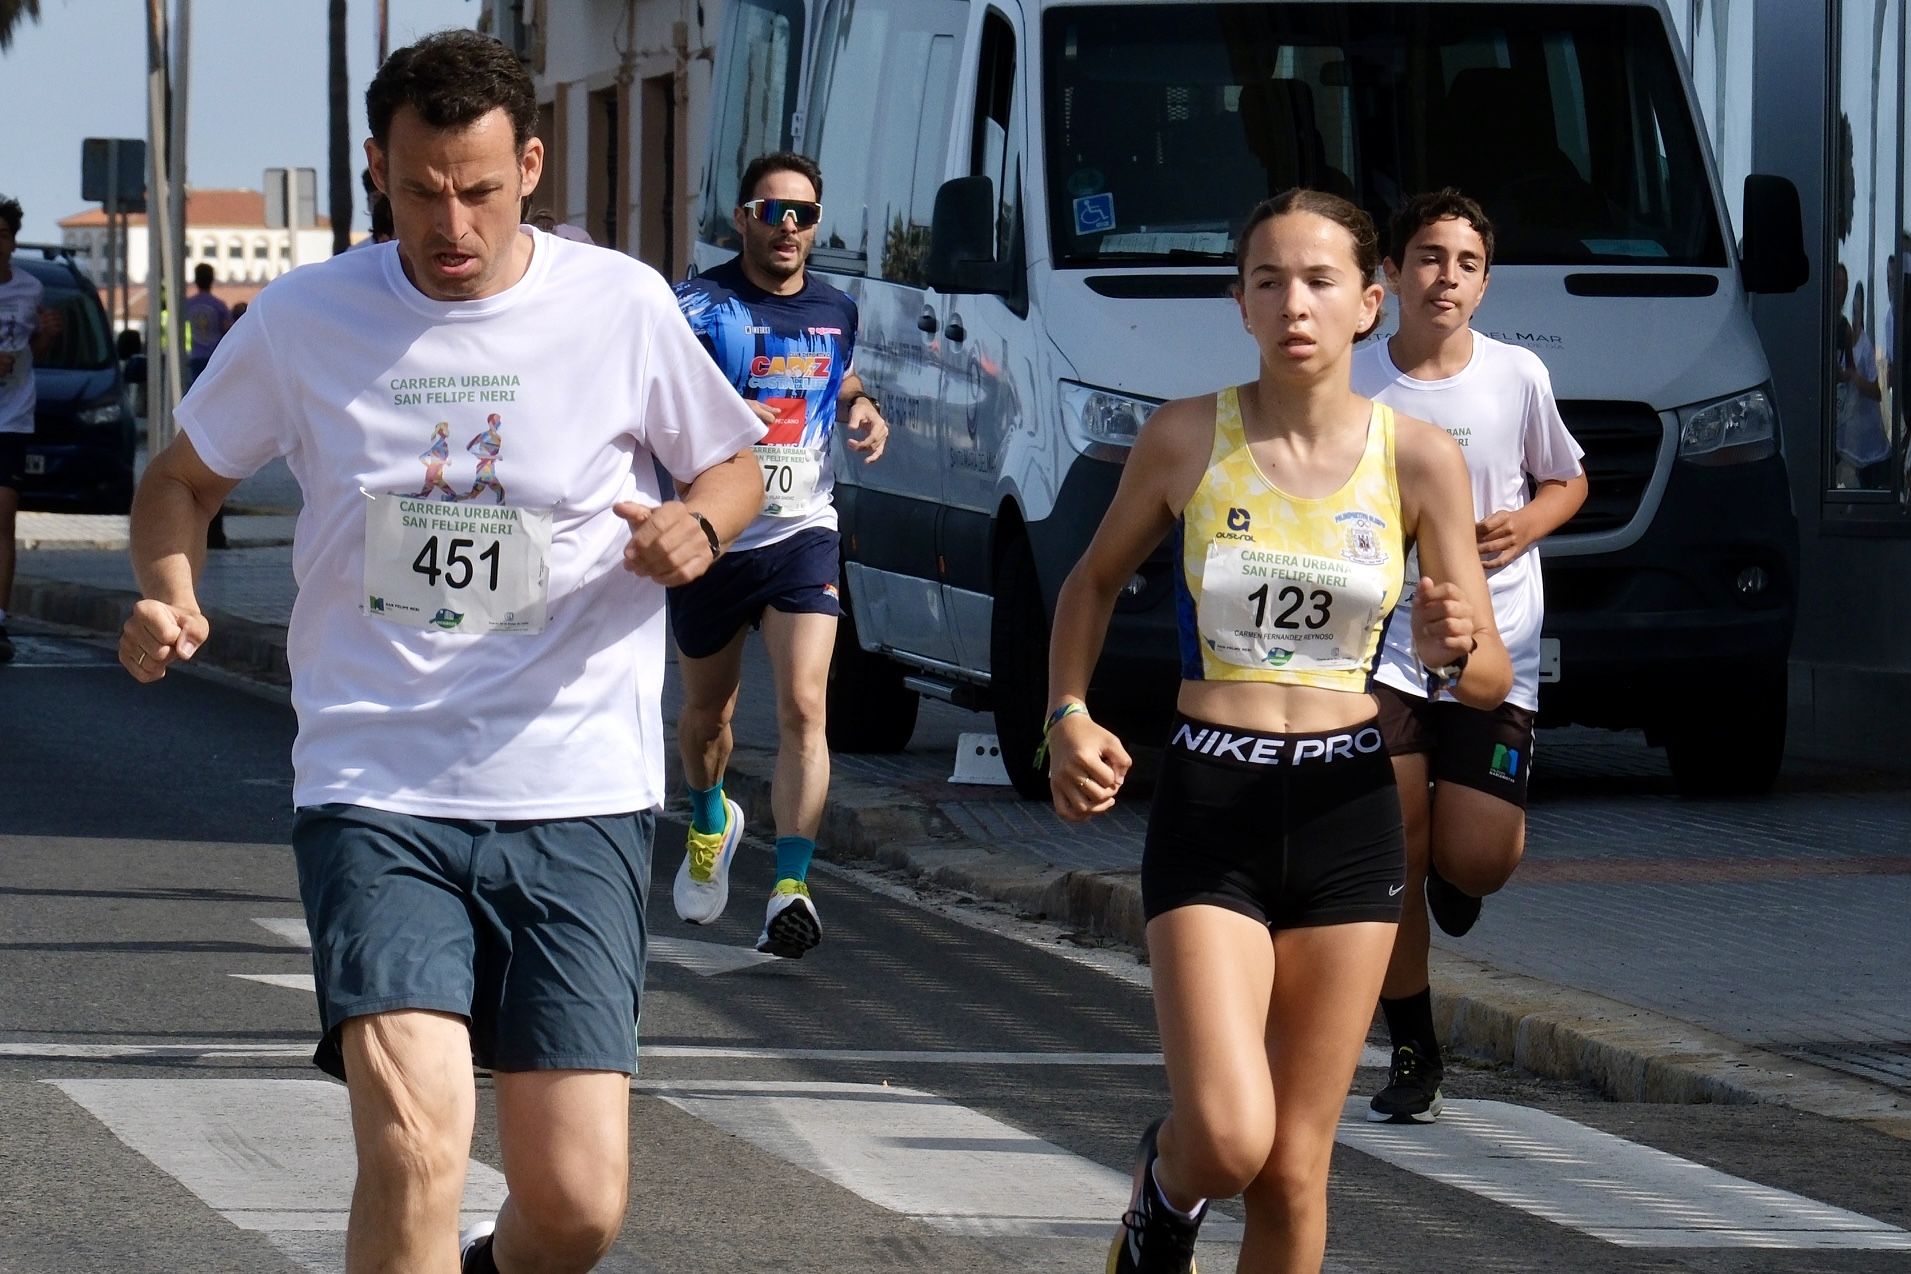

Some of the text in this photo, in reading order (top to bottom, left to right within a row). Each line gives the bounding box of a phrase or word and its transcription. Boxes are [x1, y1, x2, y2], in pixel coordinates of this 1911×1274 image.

[1515, 332, 1562, 343] MAR
[751, 355, 831, 378] CADIZ
[390, 375, 520, 390] CARRERA URBANA
[394, 390, 516, 406] SAN FELIPE NERI
[1446, 427, 1472, 436] BANA
[1456, 438, 1469, 446] RI
[764, 464, 793, 493] 70
[399, 501, 518, 521] CARRERA URBANA
[402, 515, 513, 535] SAN FELIPE NERI
[412, 535, 500, 591] 451
[1241, 550, 1299, 567] CARRERA
[1302, 557, 1352, 574] URBANA
[1242, 564, 1348, 588] SAN FELIPE NERI
[1248, 583, 1333, 630] 123
[1234, 629, 1334, 641] CARMEN FERNANDEZ REYNOSO
[1171, 723, 1382, 766] NIKE PRO
